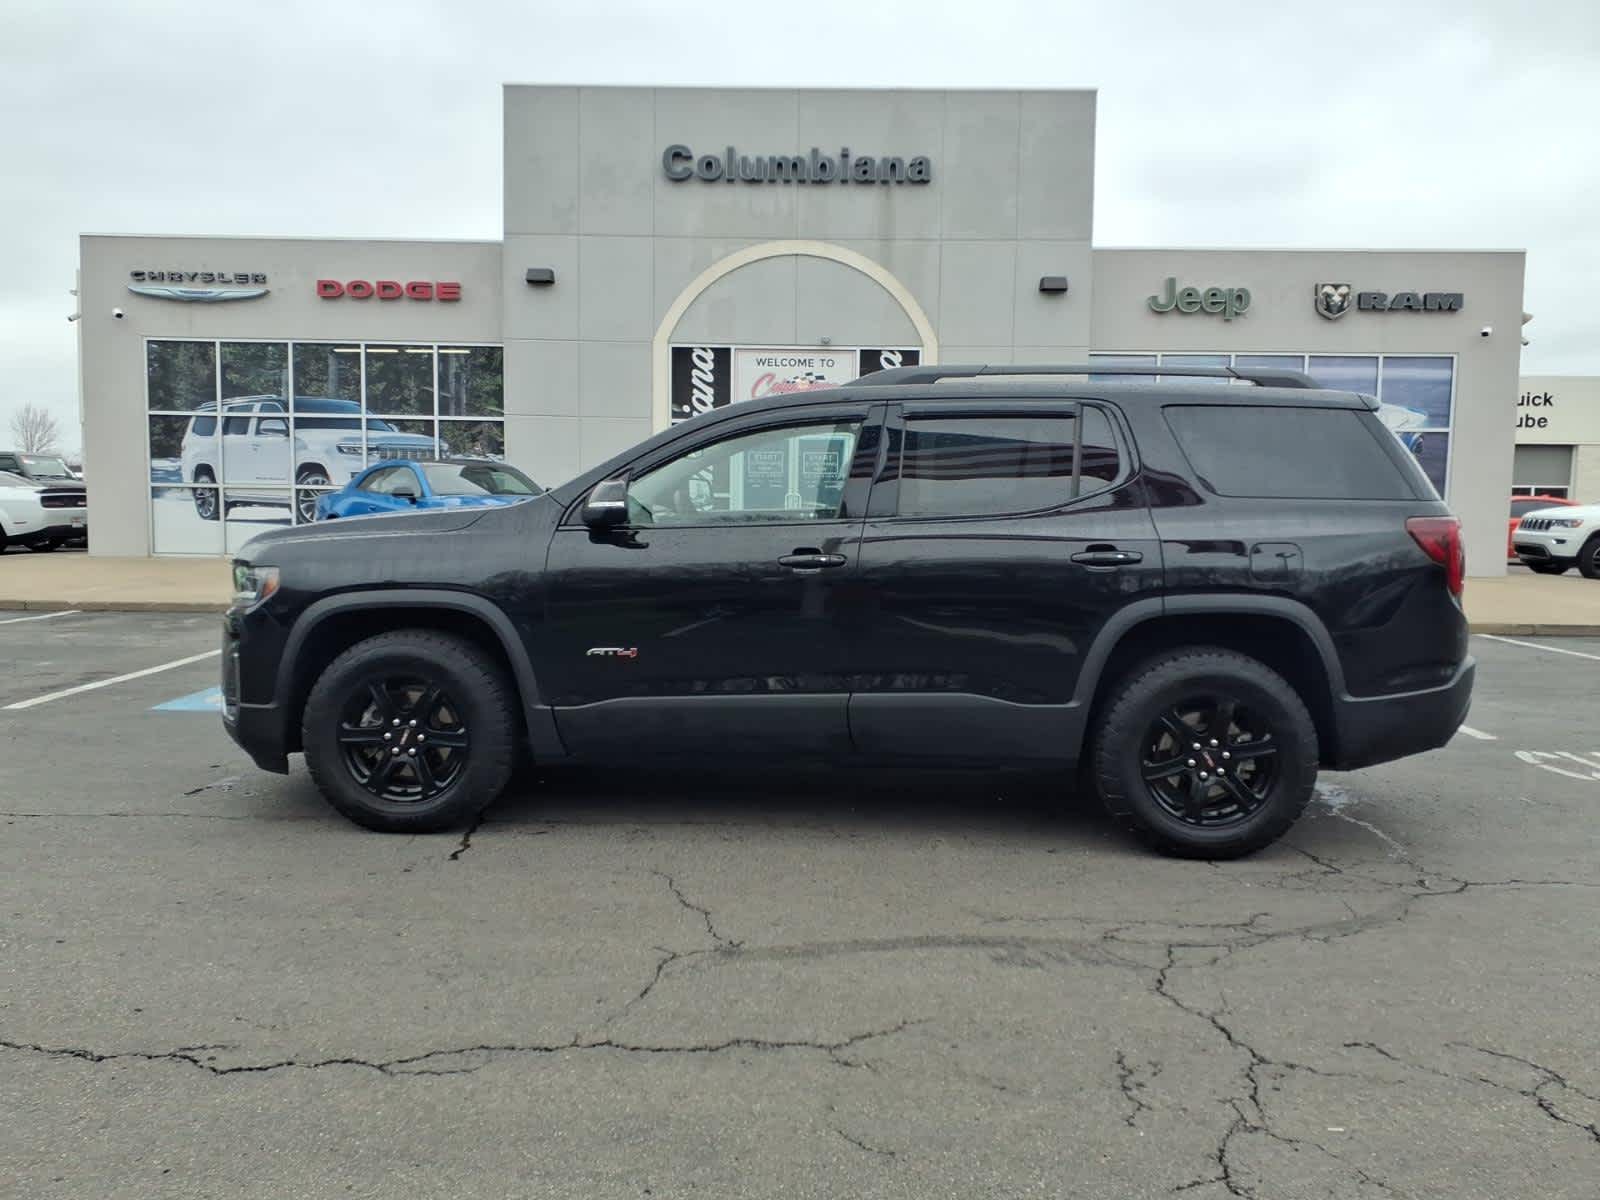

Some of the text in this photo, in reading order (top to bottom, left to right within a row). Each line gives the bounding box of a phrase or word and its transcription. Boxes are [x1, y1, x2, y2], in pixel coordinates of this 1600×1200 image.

[662, 144, 931, 184] Columbiana
[130, 271, 267, 284] CHRYSLER
[317, 279, 461, 301] DODGE
[1148, 276, 1250, 321] Jeep
[1358, 292, 1464, 312] RAM
[756, 358, 836, 368] WELCOME TO
[586, 647, 638, 658] AT4
